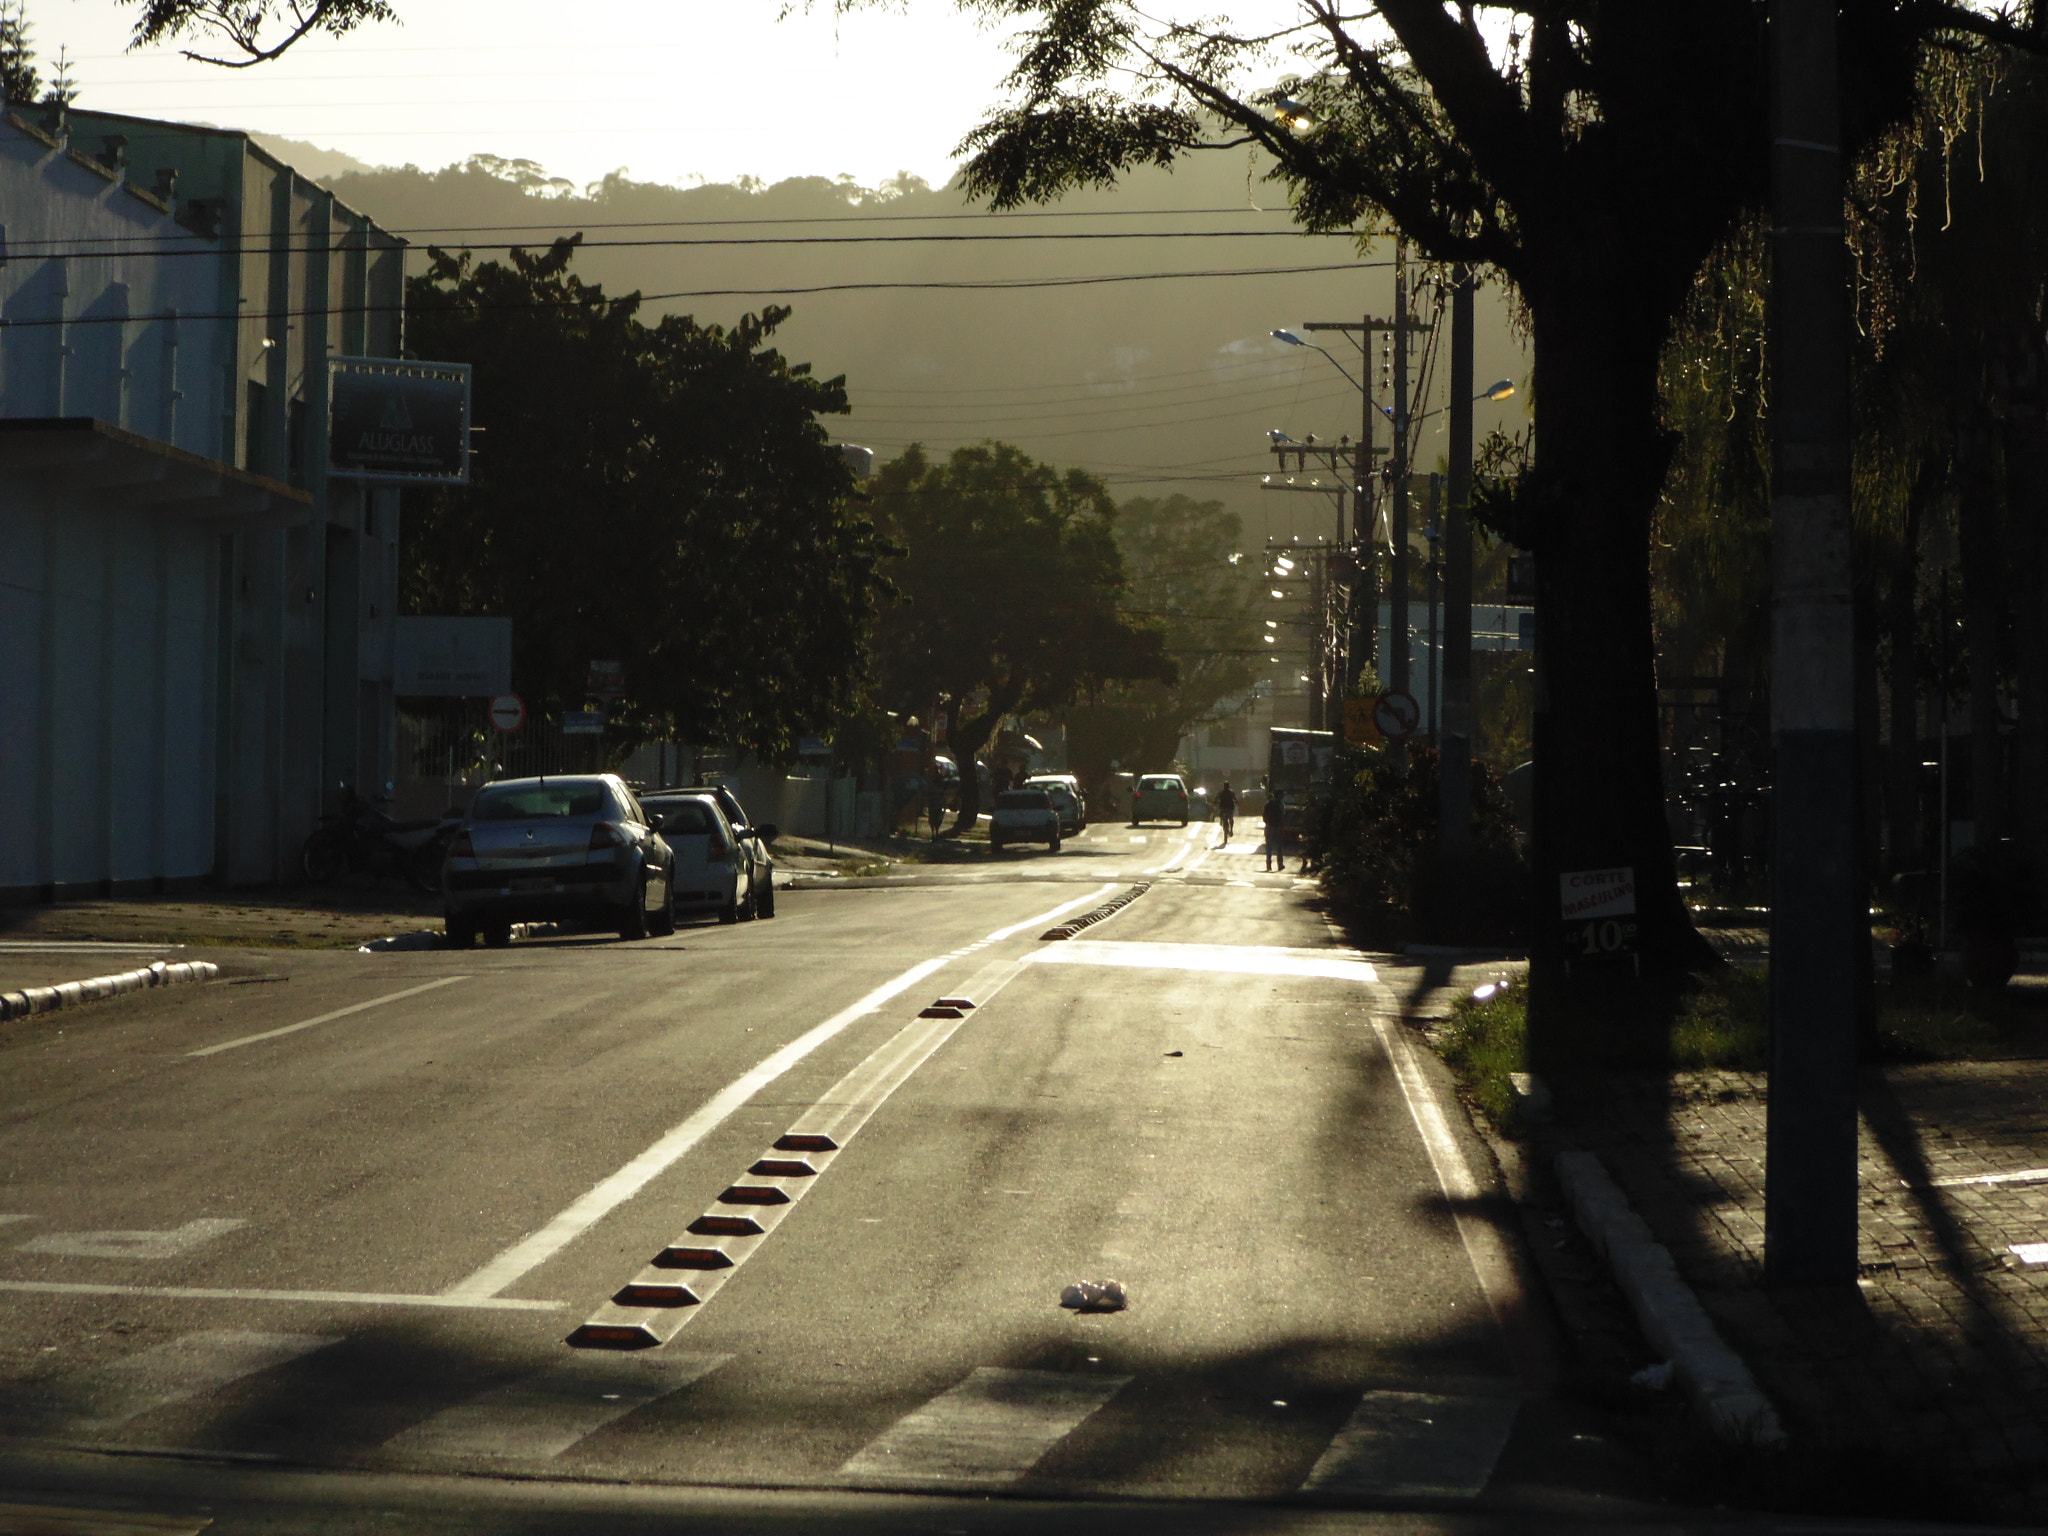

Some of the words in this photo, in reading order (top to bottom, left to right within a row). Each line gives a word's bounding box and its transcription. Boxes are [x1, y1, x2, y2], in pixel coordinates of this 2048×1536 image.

[358, 431, 435, 454] ALUGLASS
[1569, 871, 1626, 888] CORTE
[1562, 883, 1634, 916] MASCULINO
